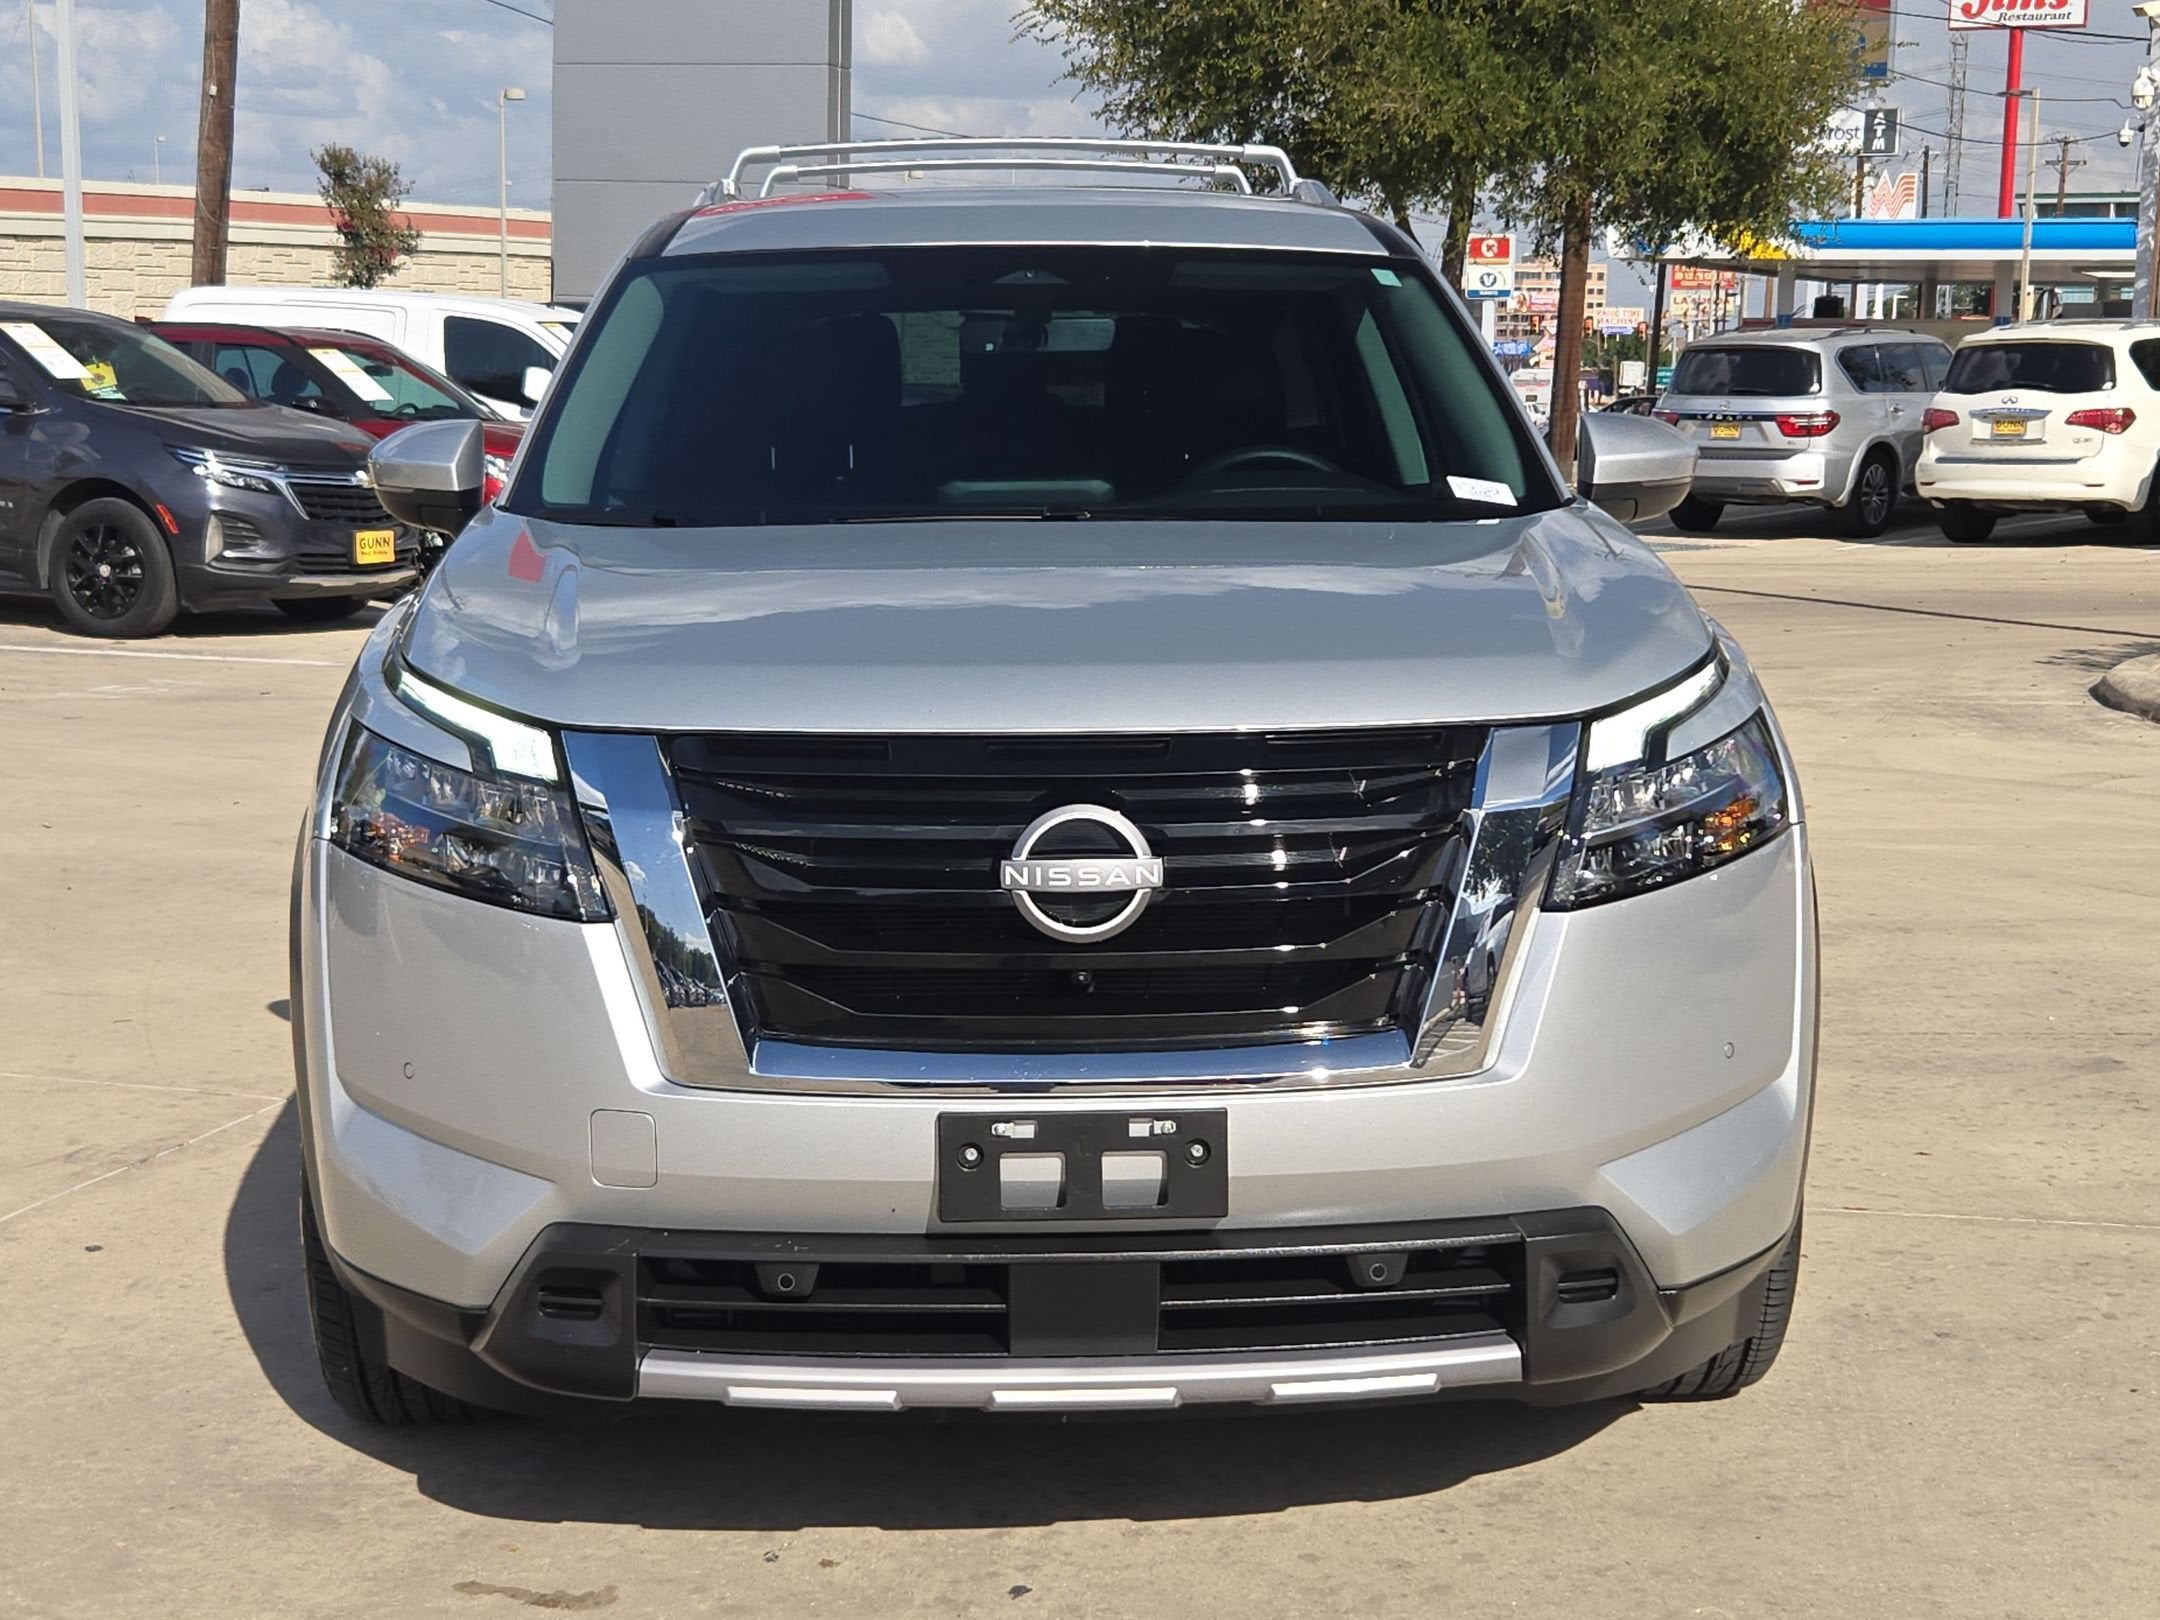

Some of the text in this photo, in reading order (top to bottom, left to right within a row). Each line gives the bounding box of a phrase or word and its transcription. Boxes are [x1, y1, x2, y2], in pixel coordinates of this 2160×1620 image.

[1997, 11, 2072, 22] Restaurant
[1872, 111, 1887, 151] ATM
[359, 536, 391, 550] GUNN
[1005, 864, 1159, 886] NISSAN
